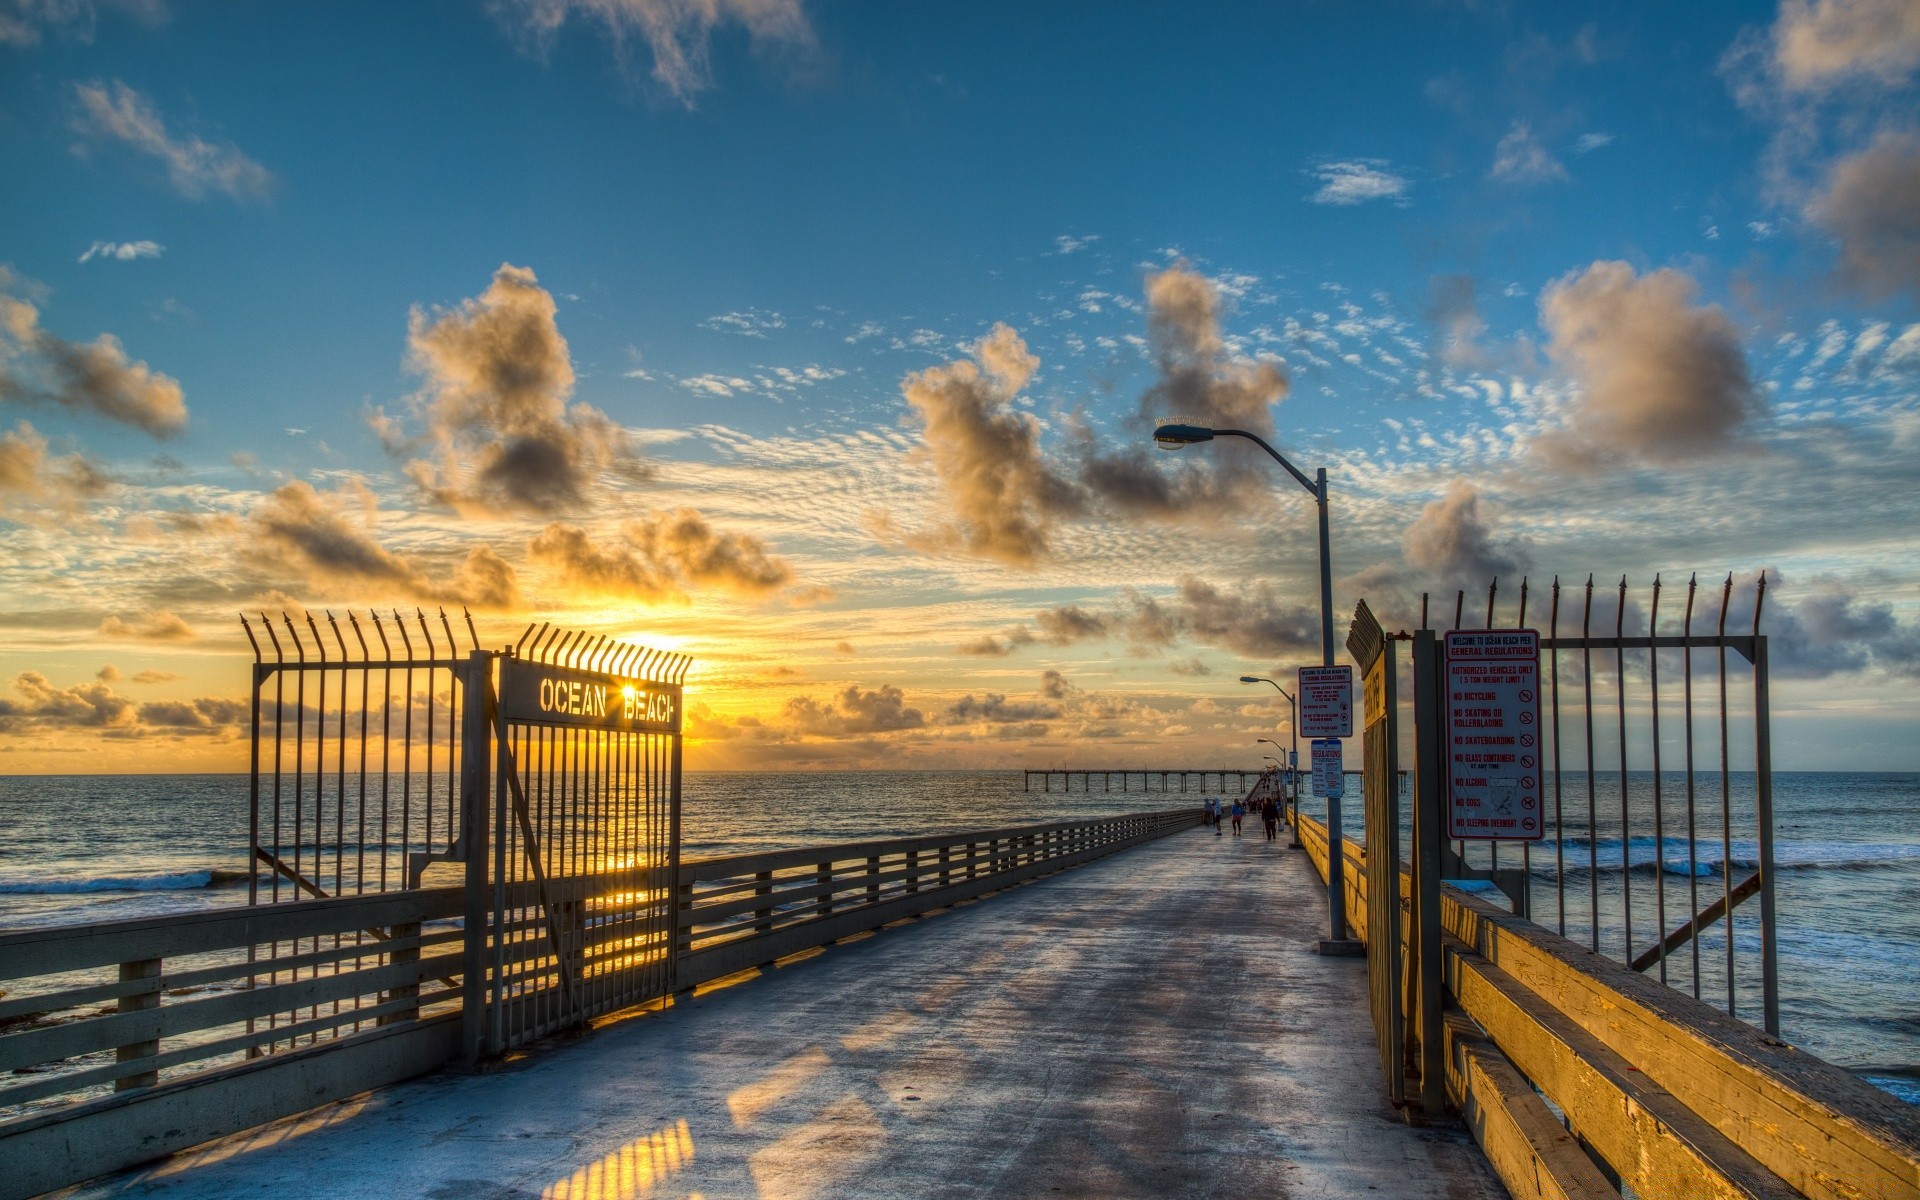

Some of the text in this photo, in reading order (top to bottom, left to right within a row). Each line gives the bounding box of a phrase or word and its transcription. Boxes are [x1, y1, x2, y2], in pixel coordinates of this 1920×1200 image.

[1452, 636, 1531, 645] WELCOME TO OCEAN BEACH PIER
[1452, 646, 1533, 655] GENERAL REGULATIONS
[1452, 666, 1487, 674] AUTHORIZED
[1489, 666, 1516, 674] VEHICLES
[540, 678, 607, 717] OCEAN
[1453, 692, 1496, 700] NO BICYCLING
[1453, 708, 1502, 717] NO SKATING OR
[1454, 719, 1504, 727] ROLLERBLADING
[1454, 736, 1515, 745] NO SKATEBOARDING
[1455, 754, 1516, 762] NO GLASS CONTAINERS
[1455, 777, 1488, 786] NO ALCOHOL
[1455, 798, 1481, 807] NO DOGS
[1456, 818, 1517, 827] NO SLEEPING OVERNIGHT
